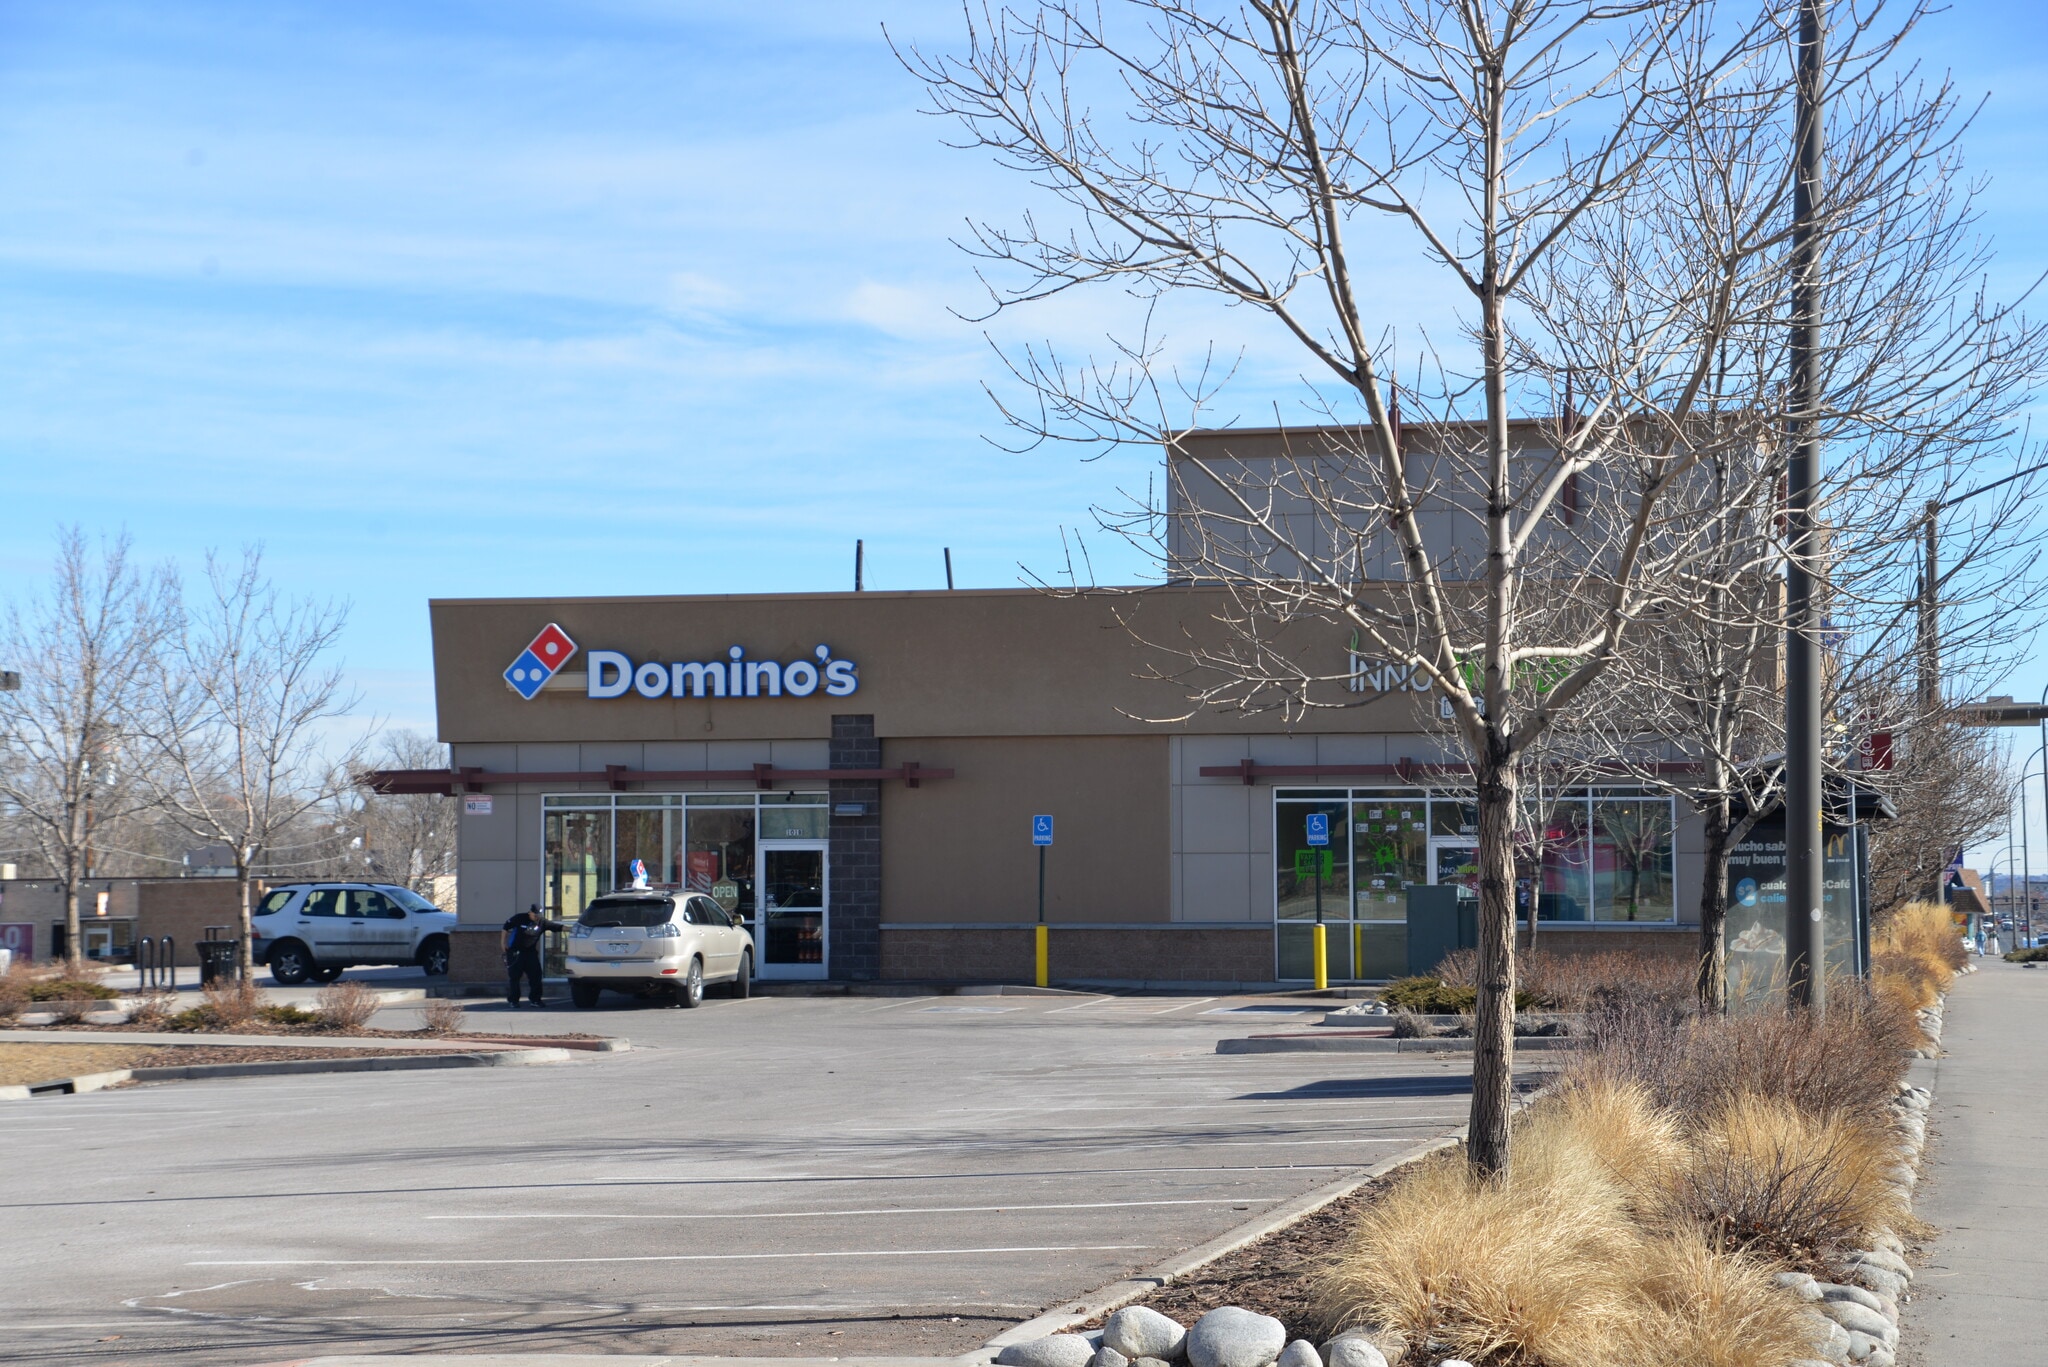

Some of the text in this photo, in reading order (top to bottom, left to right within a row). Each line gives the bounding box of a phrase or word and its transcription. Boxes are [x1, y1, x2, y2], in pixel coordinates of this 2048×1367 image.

[586, 643, 860, 699] Domino's
[466, 802, 476, 810] NO
[1728, 855, 1751, 867] muy
[1752, 853, 1780, 865] buen
[712, 885, 738, 898] OPEN
